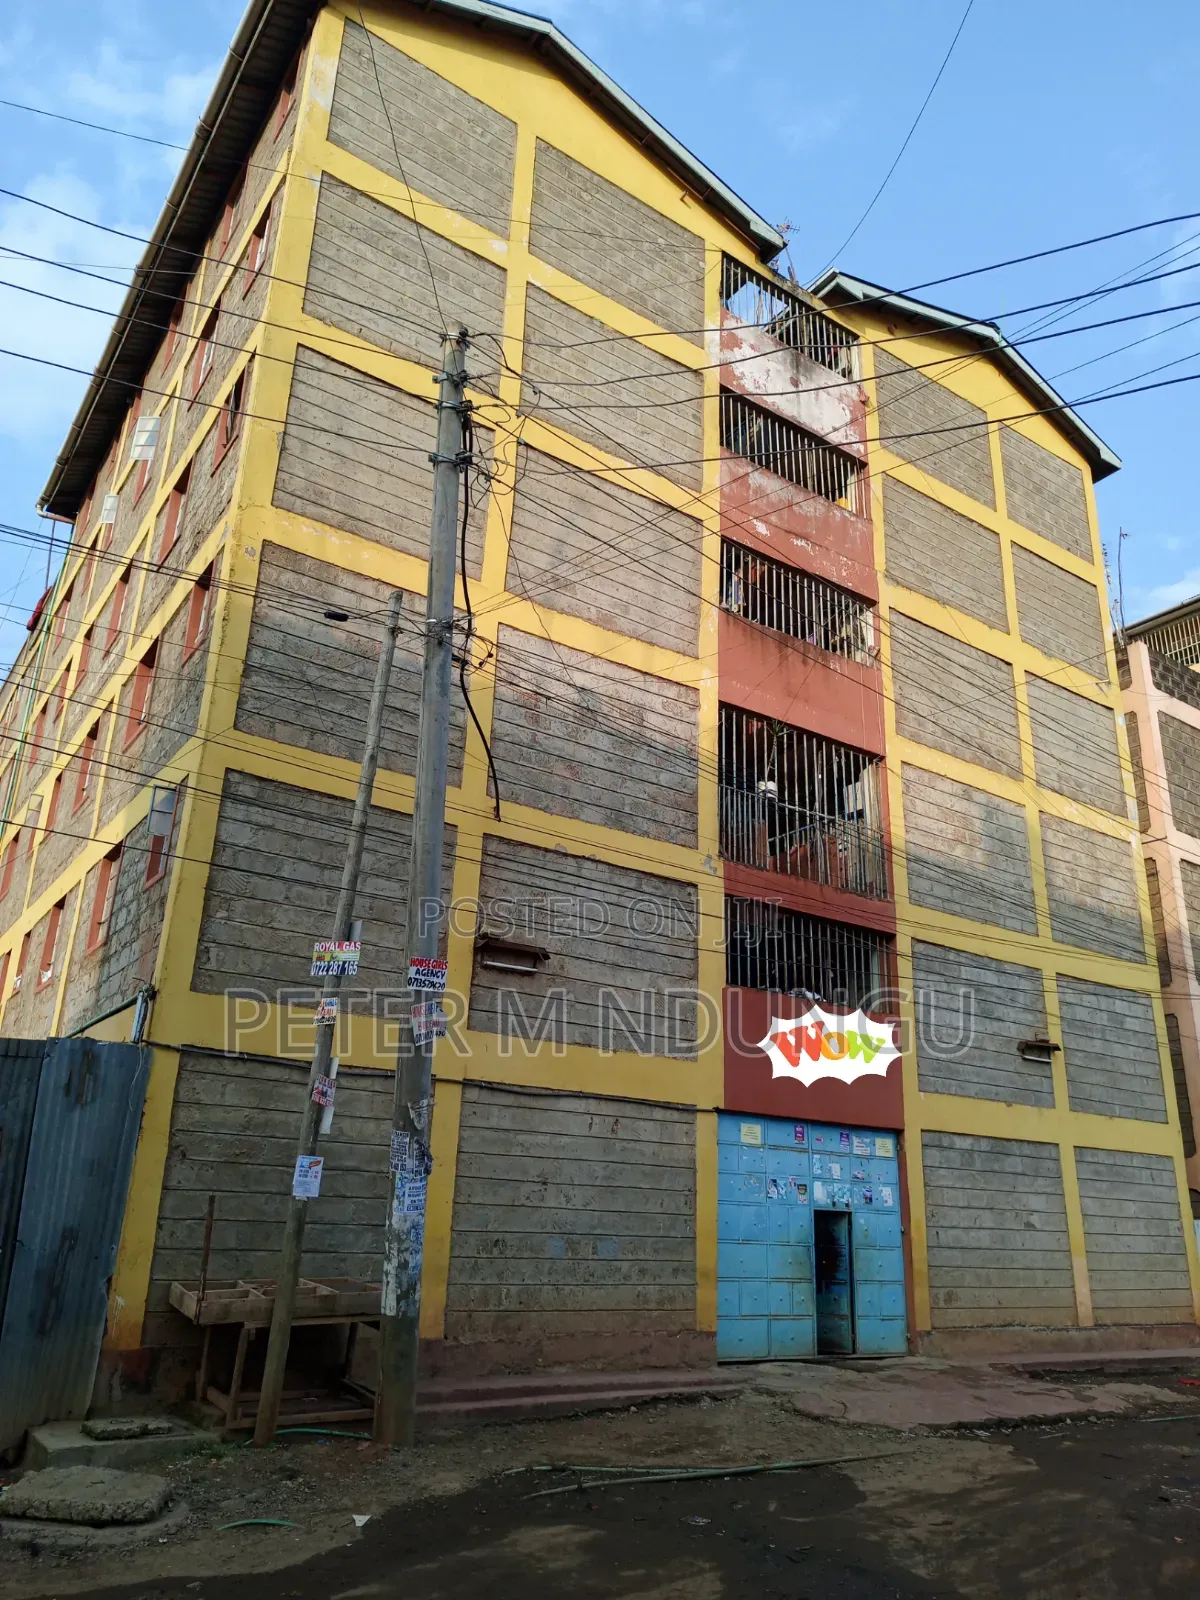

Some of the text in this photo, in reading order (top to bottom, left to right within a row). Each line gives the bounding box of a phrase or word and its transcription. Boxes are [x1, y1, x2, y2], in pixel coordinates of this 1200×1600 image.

[314, 941, 361, 952] ROYAL GAS
[311, 961, 358, 975] 0722 287 165
[415, 968, 446, 979] AGENCY
